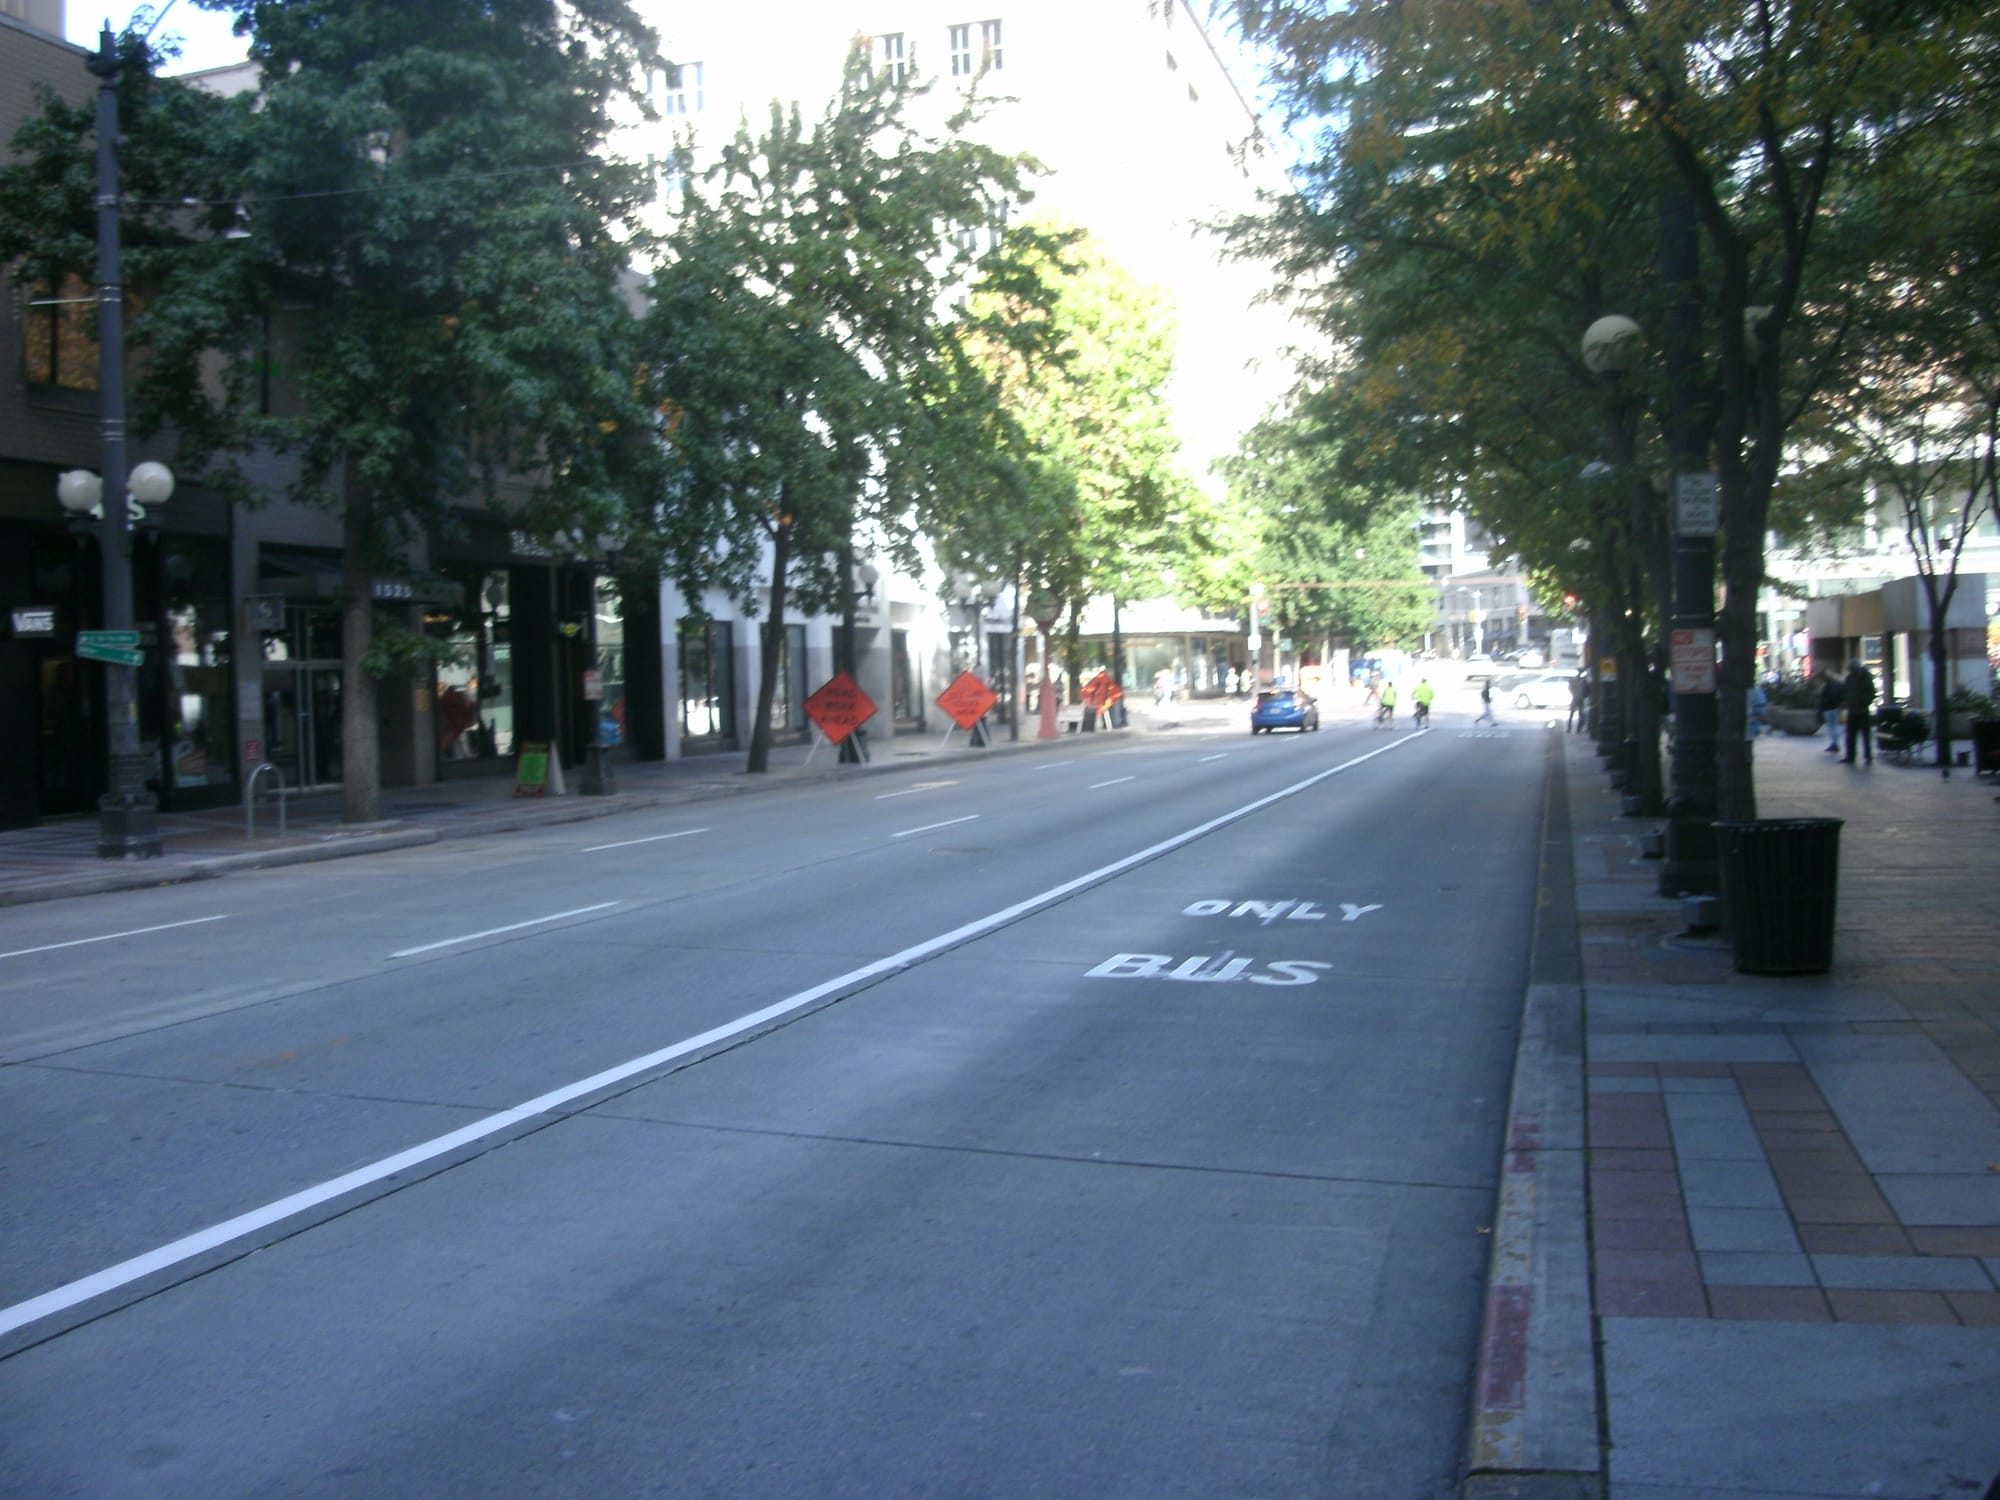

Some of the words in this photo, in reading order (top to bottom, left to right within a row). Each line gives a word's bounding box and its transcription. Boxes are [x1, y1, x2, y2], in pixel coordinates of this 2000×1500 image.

[375, 584, 412, 598] 1525
[12, 611, 54, 632] VANS
[1181, 899, 1384, 923] ONLY
[1082, 952, 1334, 986] BUS
